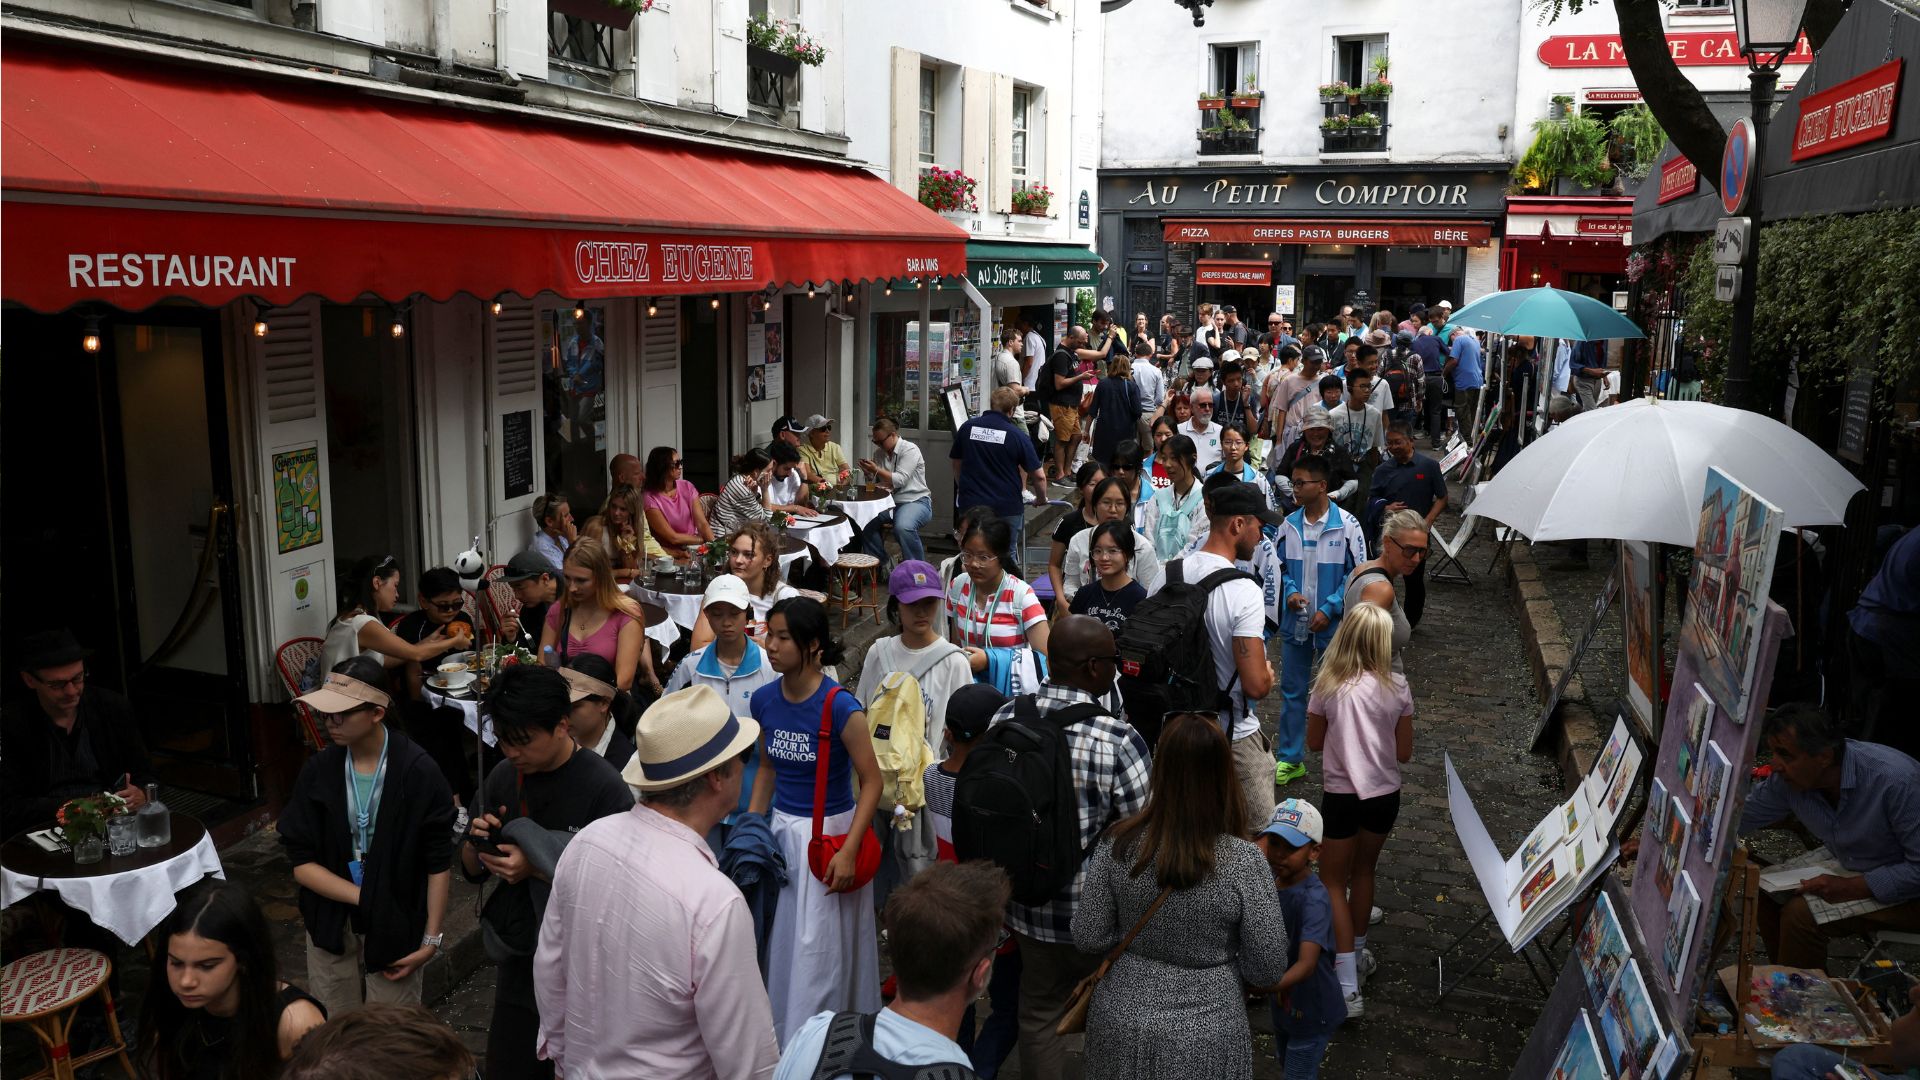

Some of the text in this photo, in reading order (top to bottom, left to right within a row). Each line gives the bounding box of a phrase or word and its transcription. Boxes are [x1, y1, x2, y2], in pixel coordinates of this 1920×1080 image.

[1566, 41, 1600, 60] LA
[1607, 40, 1688, 60] ME
[1797, 82, 1896, 150] CHEZ EUGENE
[1181, 228, 1469, 241] PIZZA CREPES PASTA BURGERS BIÈRE
[575, 240, 753, 283] CHEZ EUGENE
[907, 258, 920, 272] BAR
[925, 259, 939, 272] VINS
[68, 253, 297, 288] RESTAURANT
[1020, 268, 1030, 285] qui
[1063, 270, 1091, 280] SOUVENIRS
[1201, 271, 1221, 279] CREPES
[1251, 272, 1266, 280] AWAY
[274, 452, 318, 472] CHARTREUSE
[1151, 476, 1171, 486] Sta
[773, 729, 810, 743] GOLDEN
[772, 738, 810, 752] HOUR IN
[767, 745, 817, 762] MYKONOS
